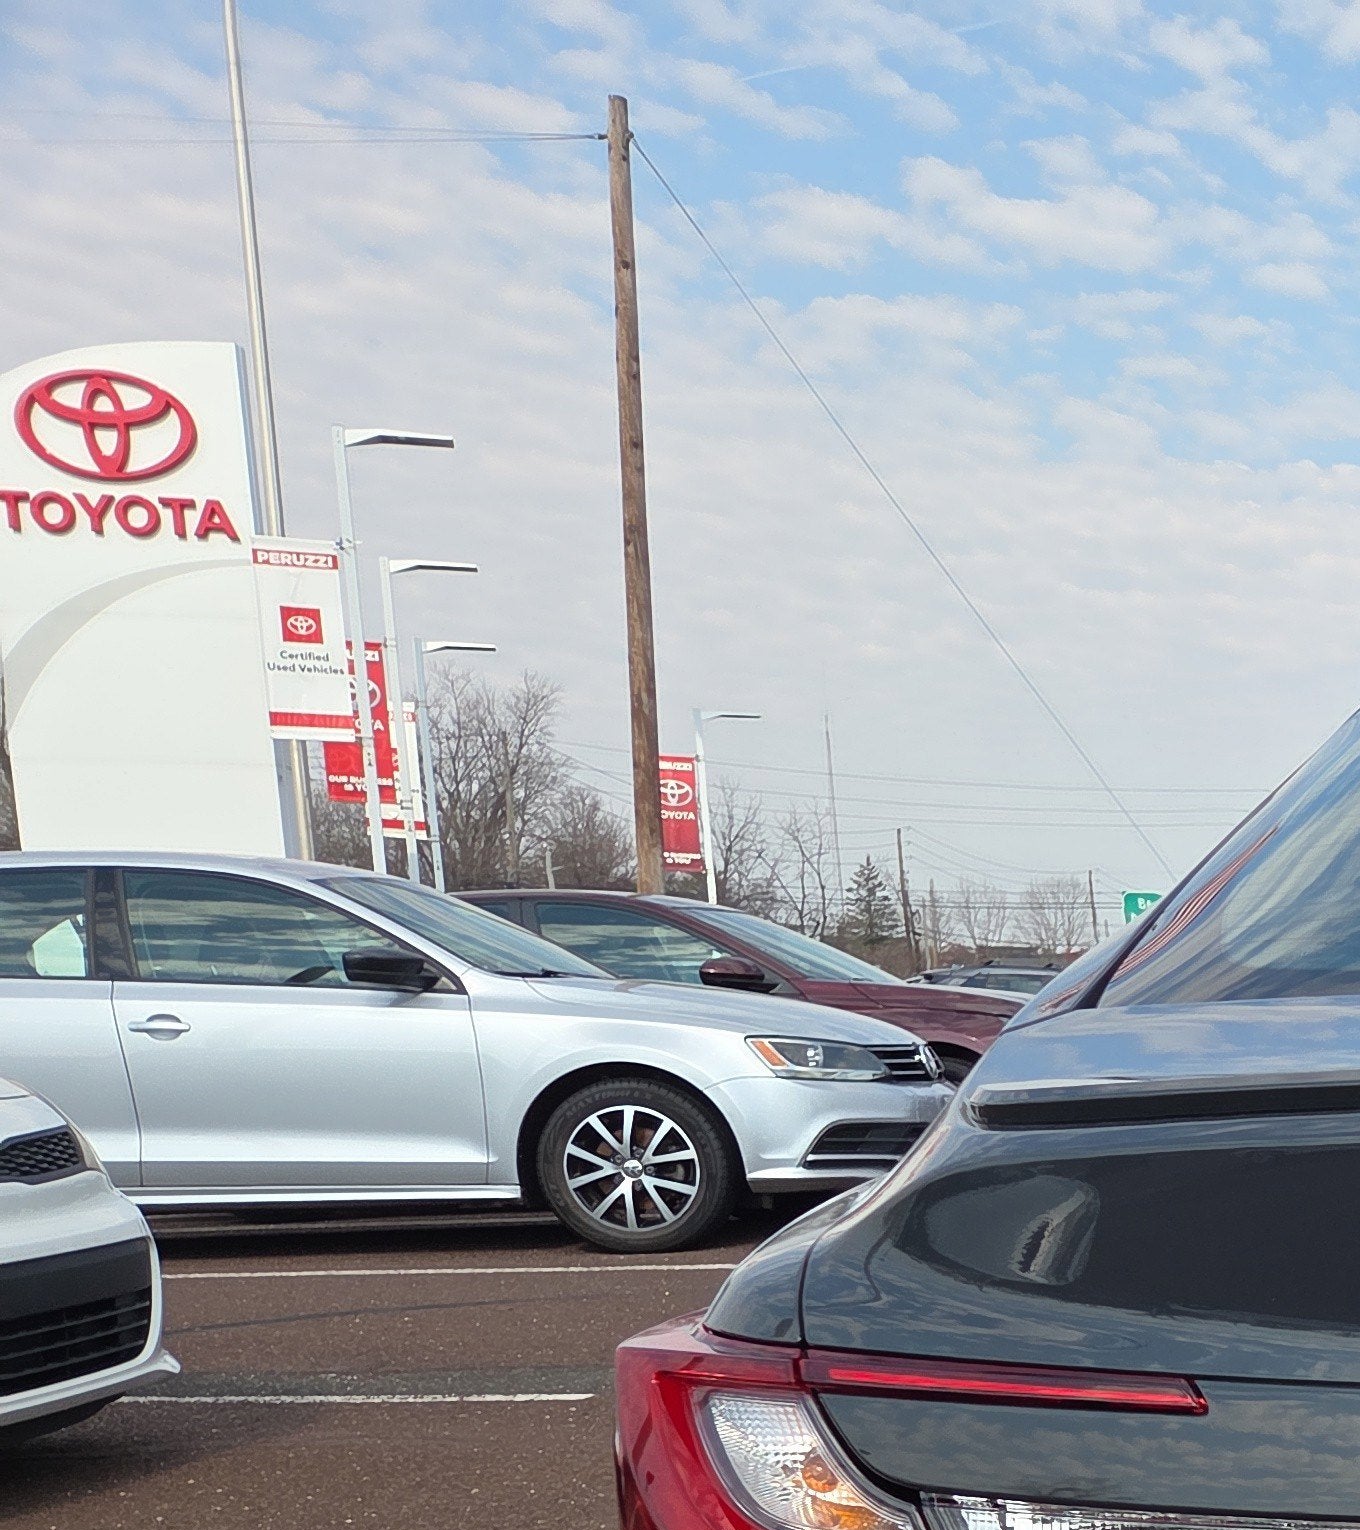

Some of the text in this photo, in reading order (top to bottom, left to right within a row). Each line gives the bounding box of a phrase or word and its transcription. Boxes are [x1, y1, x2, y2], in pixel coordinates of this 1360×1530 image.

[0, 490, 241, 543] TOYOTA
[256, 551, 334, 568] PERUZZI
[279, 650, 329, 661] Certified
[267, 662, 344, 674] Used Vehicles
[661, 810, 695, 820] OYOTA
